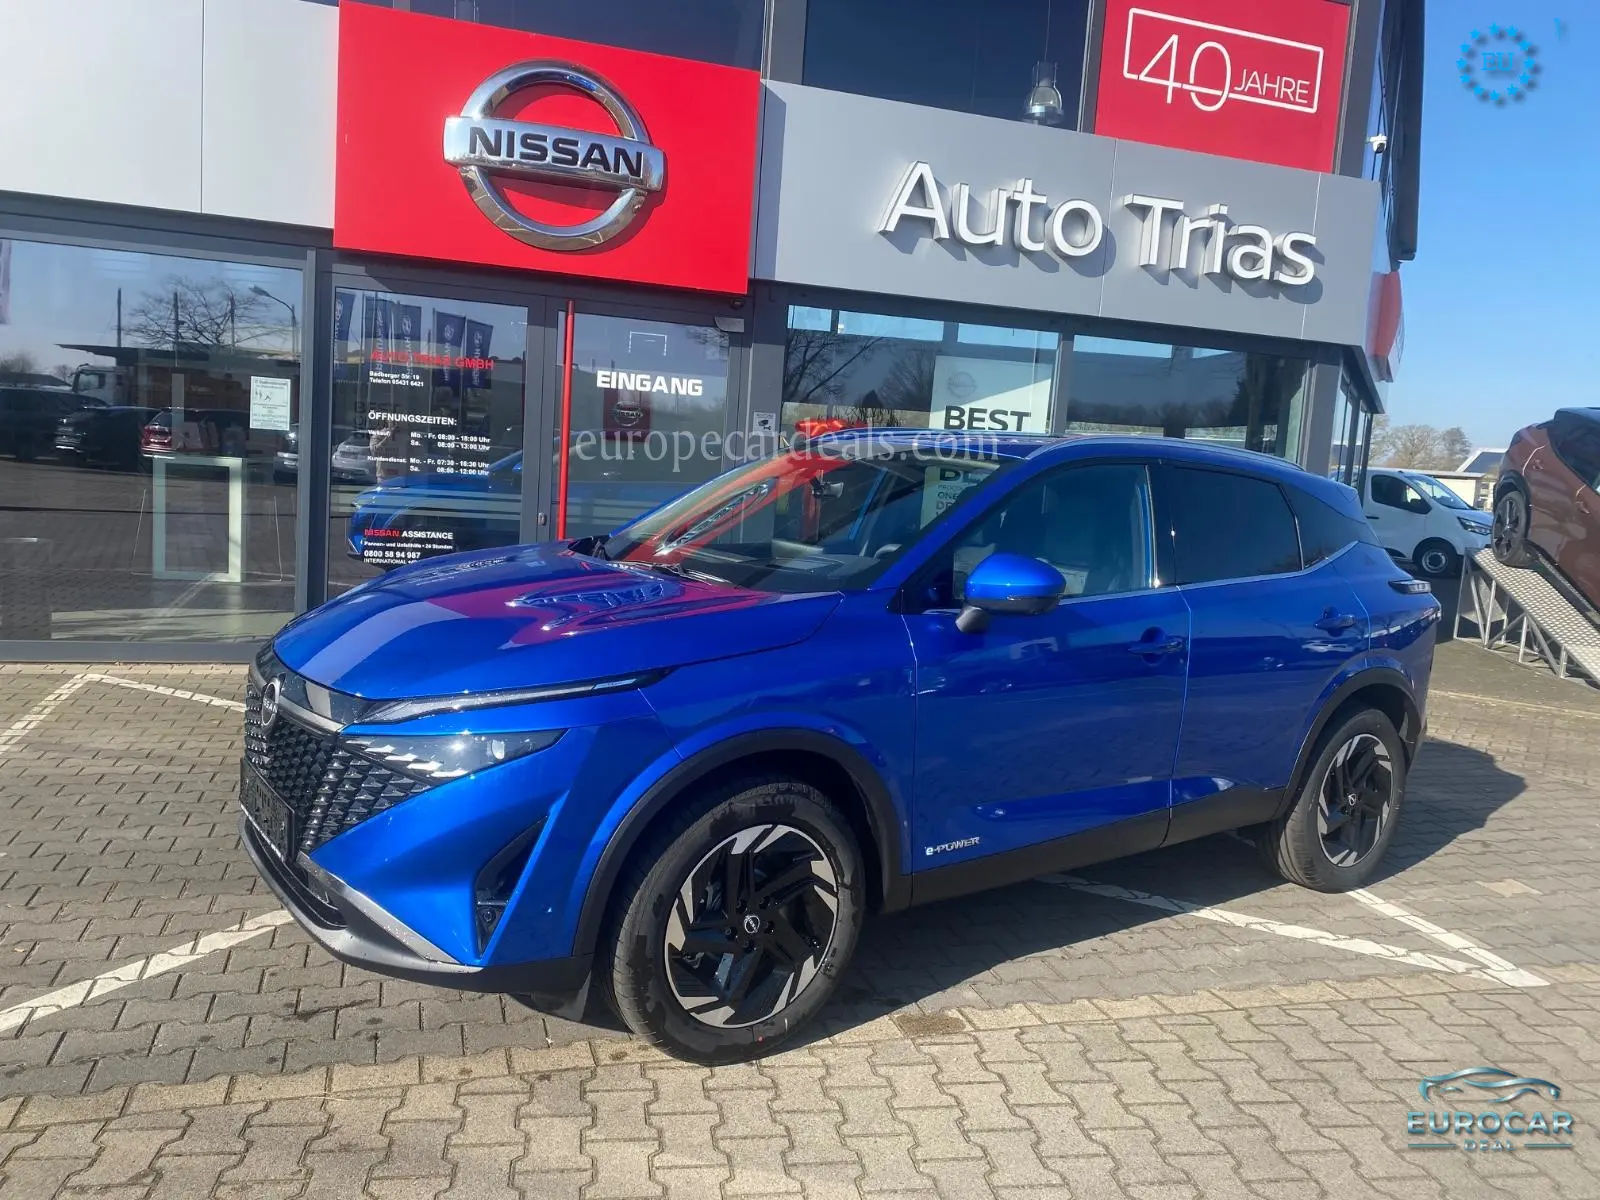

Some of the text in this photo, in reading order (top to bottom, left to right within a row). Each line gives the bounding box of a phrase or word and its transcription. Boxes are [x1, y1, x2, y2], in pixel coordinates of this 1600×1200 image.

[1138, 34, 1310, 112] 40 JAHRE
[469, 126, 643, 178] NISSAN
[878, 160, 1318, 285] Auto Trias
[455, 357, 495, 370] GMBH
[369, 377, 391, 385] Telefon
[596, 370, 704, 396] EINGANG
[368, 410, 457, 425] ÖFFNUNGSZEITEN:
[944, 405, 1032, 432] BEST
[410, 431, 421, 439] Mo.
[428, 432, 437, 440] Fr.
[478, 443, 491, 451] Uhr
[410, 465, 421, 473] Sa.
[477, 469, 490, 477] Uhr
[477, 461, 490, 470] Uhr
[364, 529, 453, 539] NISSAN ASSISTANCE
[384, 551, 394, 559] 58
[395, 551, 405, 559] 94
